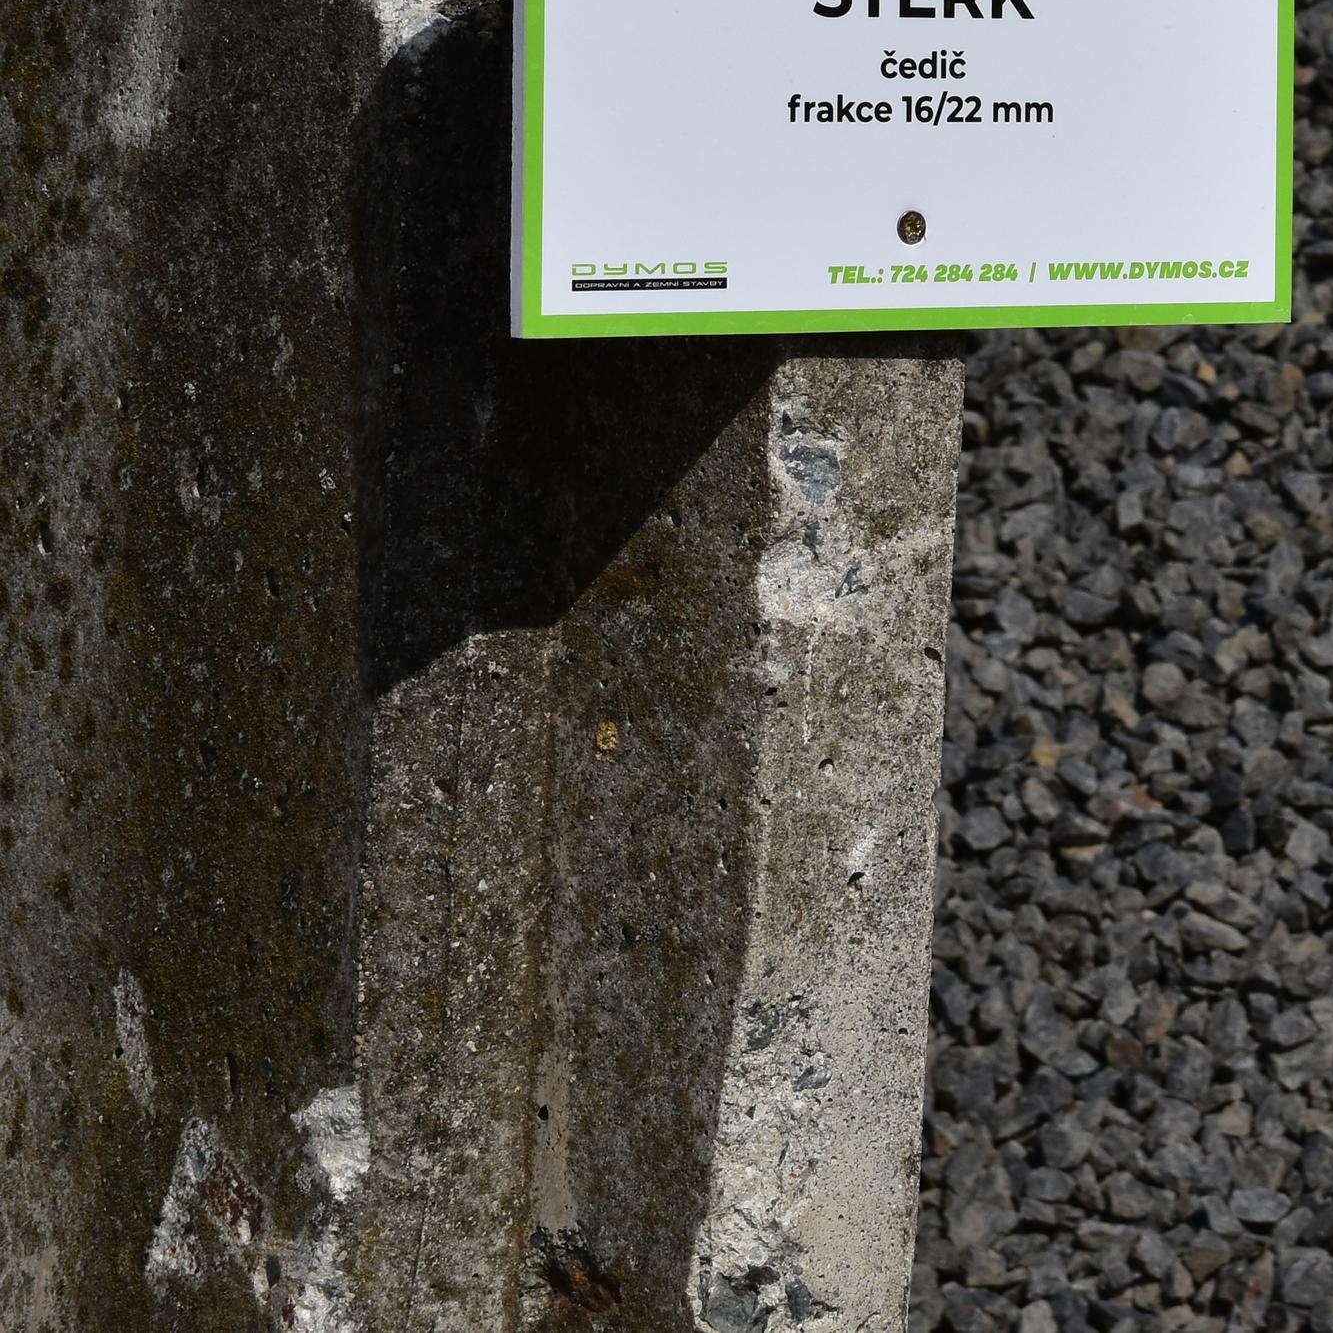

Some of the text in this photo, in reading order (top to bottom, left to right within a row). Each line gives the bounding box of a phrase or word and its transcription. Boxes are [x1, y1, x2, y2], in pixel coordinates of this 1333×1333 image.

[880, 50, 967, 80] čedič
[788, 91, 1054, 127] frakce 16/22 mm
[571, 261, 728, 277] DYMOS
[828, 265, 884, 284] TEL.:
[890, 264, 929, 284] 724
[933, 263, 974, 283] 284
[978, 263, 1019, 283] 284
[1048, 260, 1249, 281] WWW.DYMOS.CZ
[682, 279, 725, 287] STAVBY
